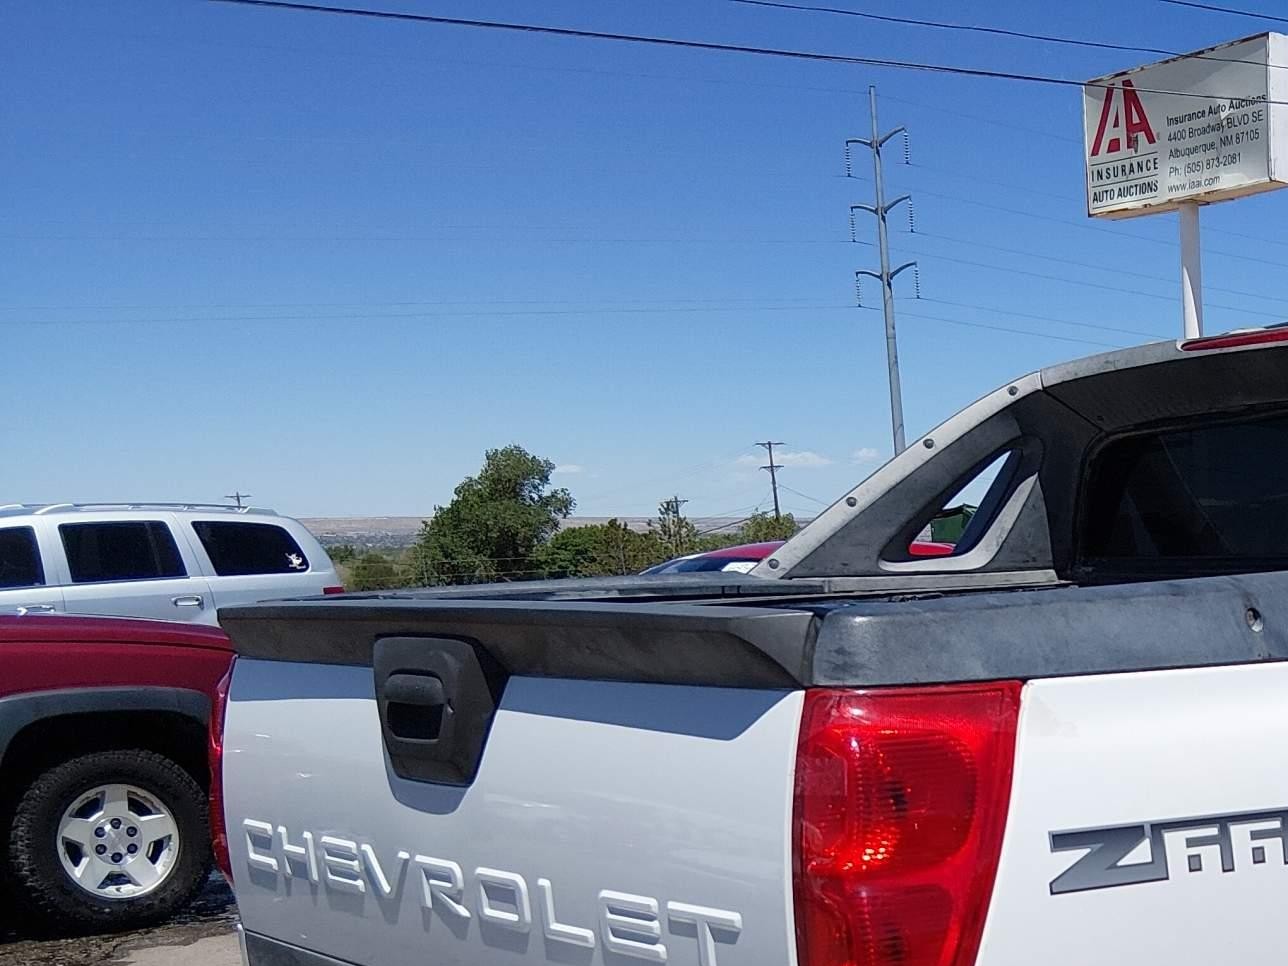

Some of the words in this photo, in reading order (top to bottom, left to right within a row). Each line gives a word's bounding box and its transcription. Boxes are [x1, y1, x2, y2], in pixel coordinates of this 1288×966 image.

[1166, 109, 1205, 127] Insurance
[1208, 104, 1226, 117] Auto
[1228, 94, 1267, 111] Auctions
[1167, 128, 1186, 142] 4400
[1188, 120, 1225, 139] Broadway
[1226, 113, 1249, 129] BLVD
[1251, 109, 1264, 123] SE
[1168, 140, 1217, 160] Albuquerque,
[1219, 135, 1234, 148] NM
[1235, 128, 1260, 144] 87105
[1091, 158, 1159, 182] INSURANCE
[1169, 166, 1182, 177] Ph:
[1184, 160, 1204, 176] (505)
[1205, 152, 1241, 170] 873-2081
[1092, 188, 1115, 204] AUTO
[1116, 180, 1159, 201] AUCTIONS
[1168, 175, 1220, 193] www.iaai.com
